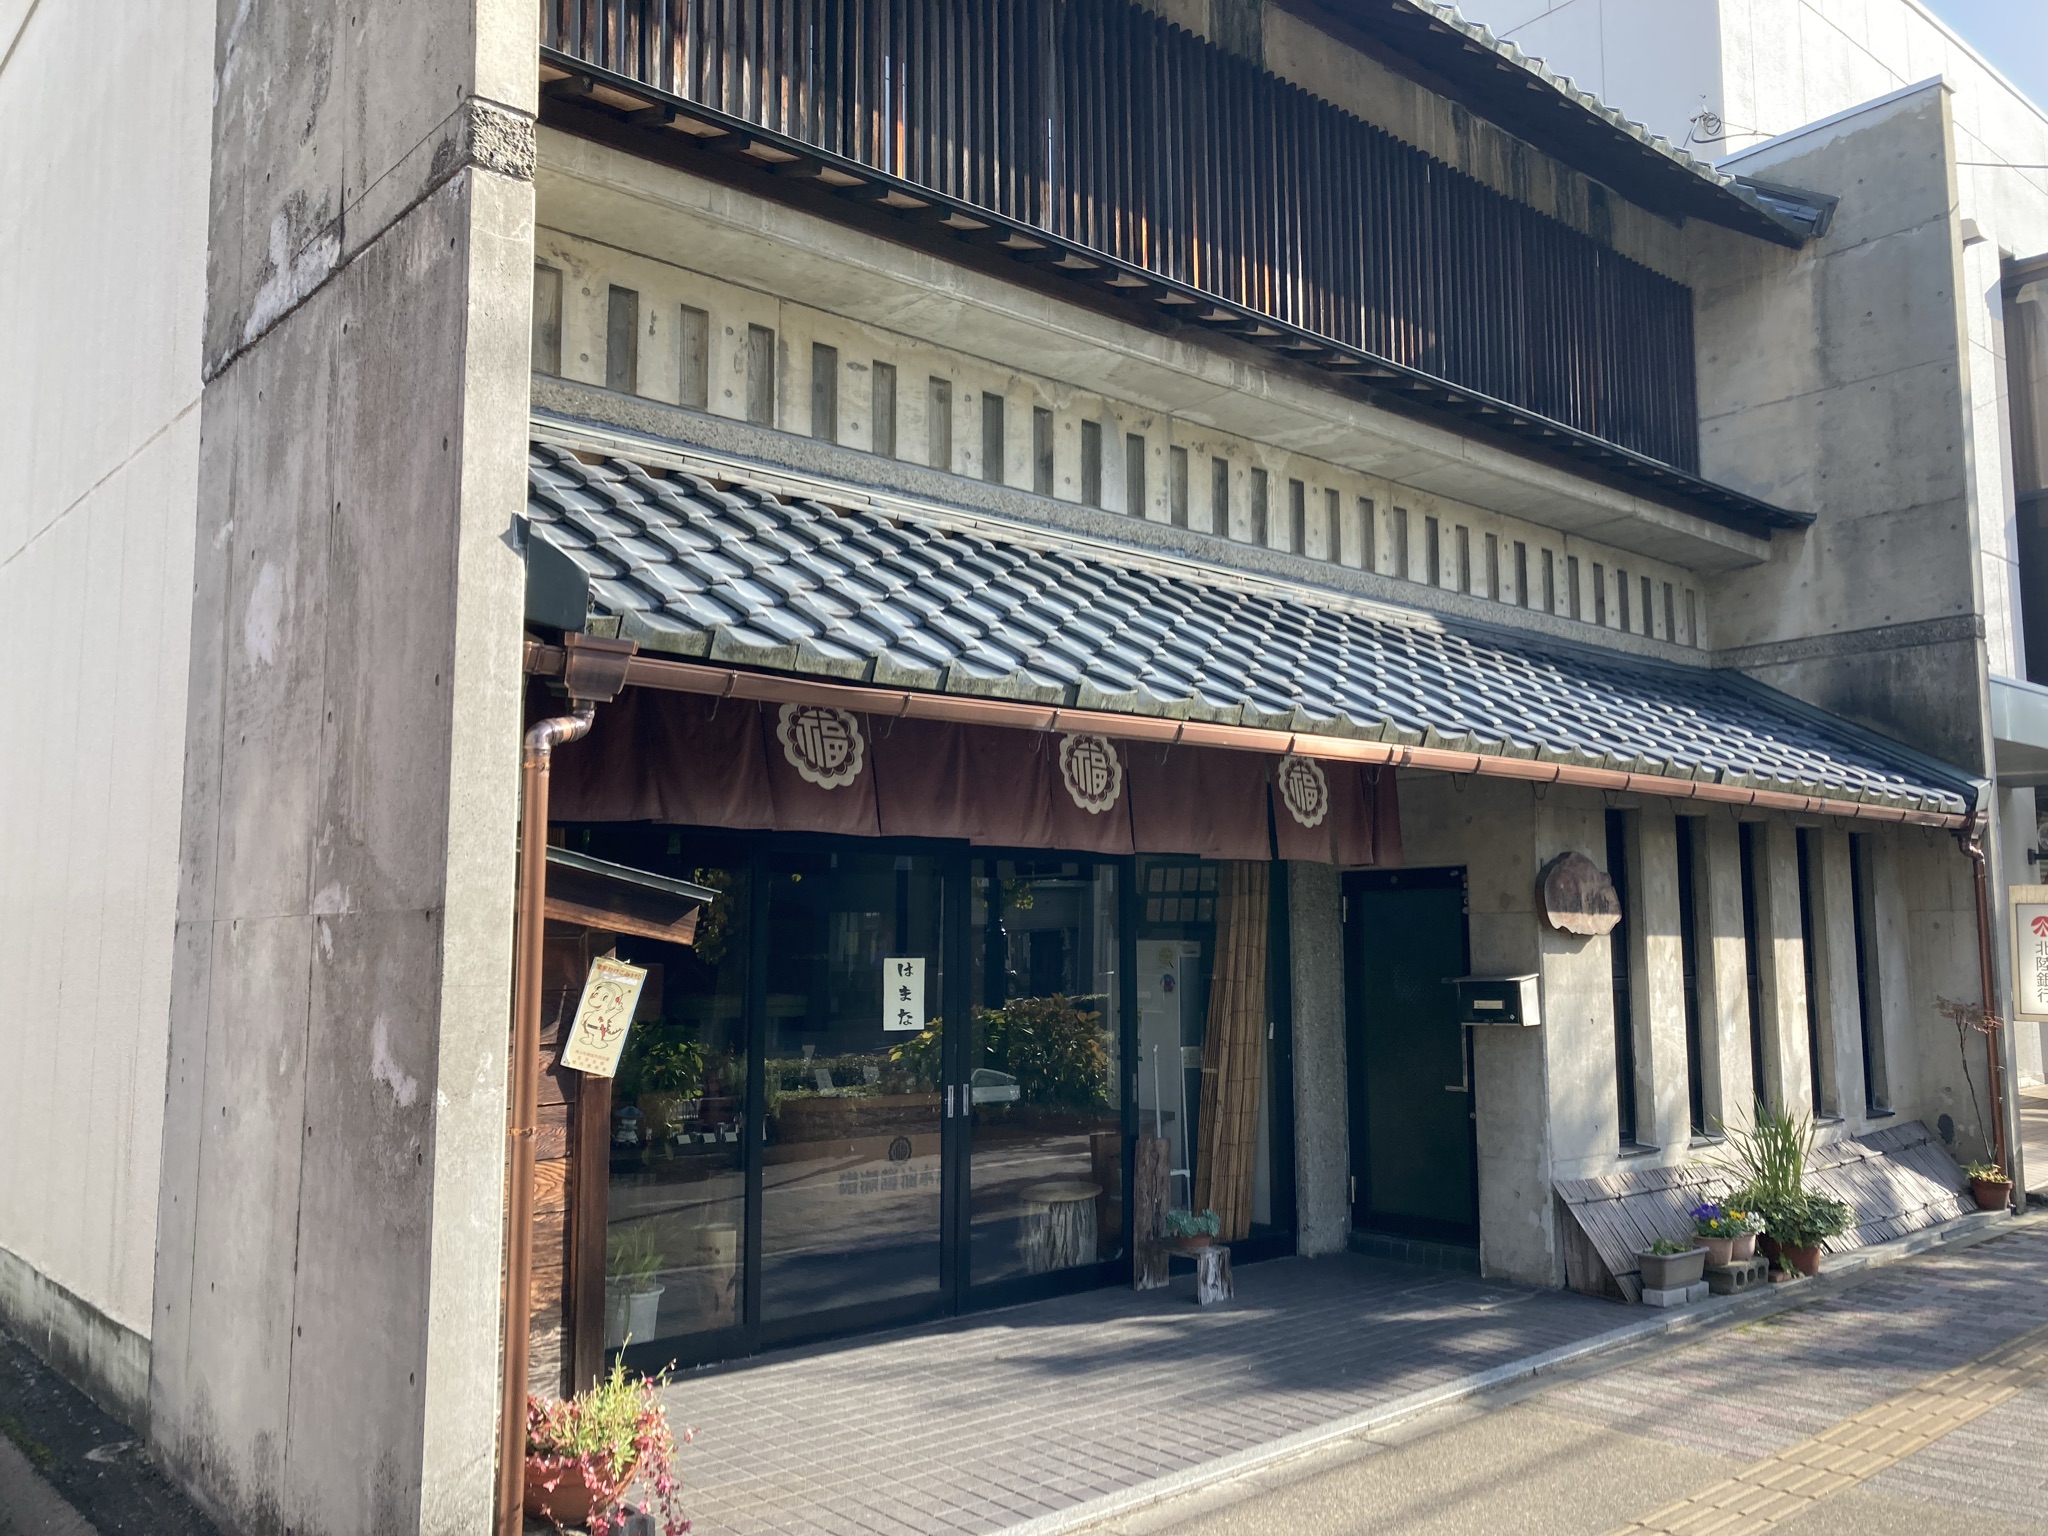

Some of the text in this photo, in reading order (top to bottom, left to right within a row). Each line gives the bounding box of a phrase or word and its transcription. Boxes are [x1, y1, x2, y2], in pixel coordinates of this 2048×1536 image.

[796, 709, 849, 769] 福
[1071, 741, 1108, 796] 福
[1289, 765, 1318, 812] 福
[897, 962, 914, 1026] はまな
[2035, 940, 2048, 1003] 北陸銀行
